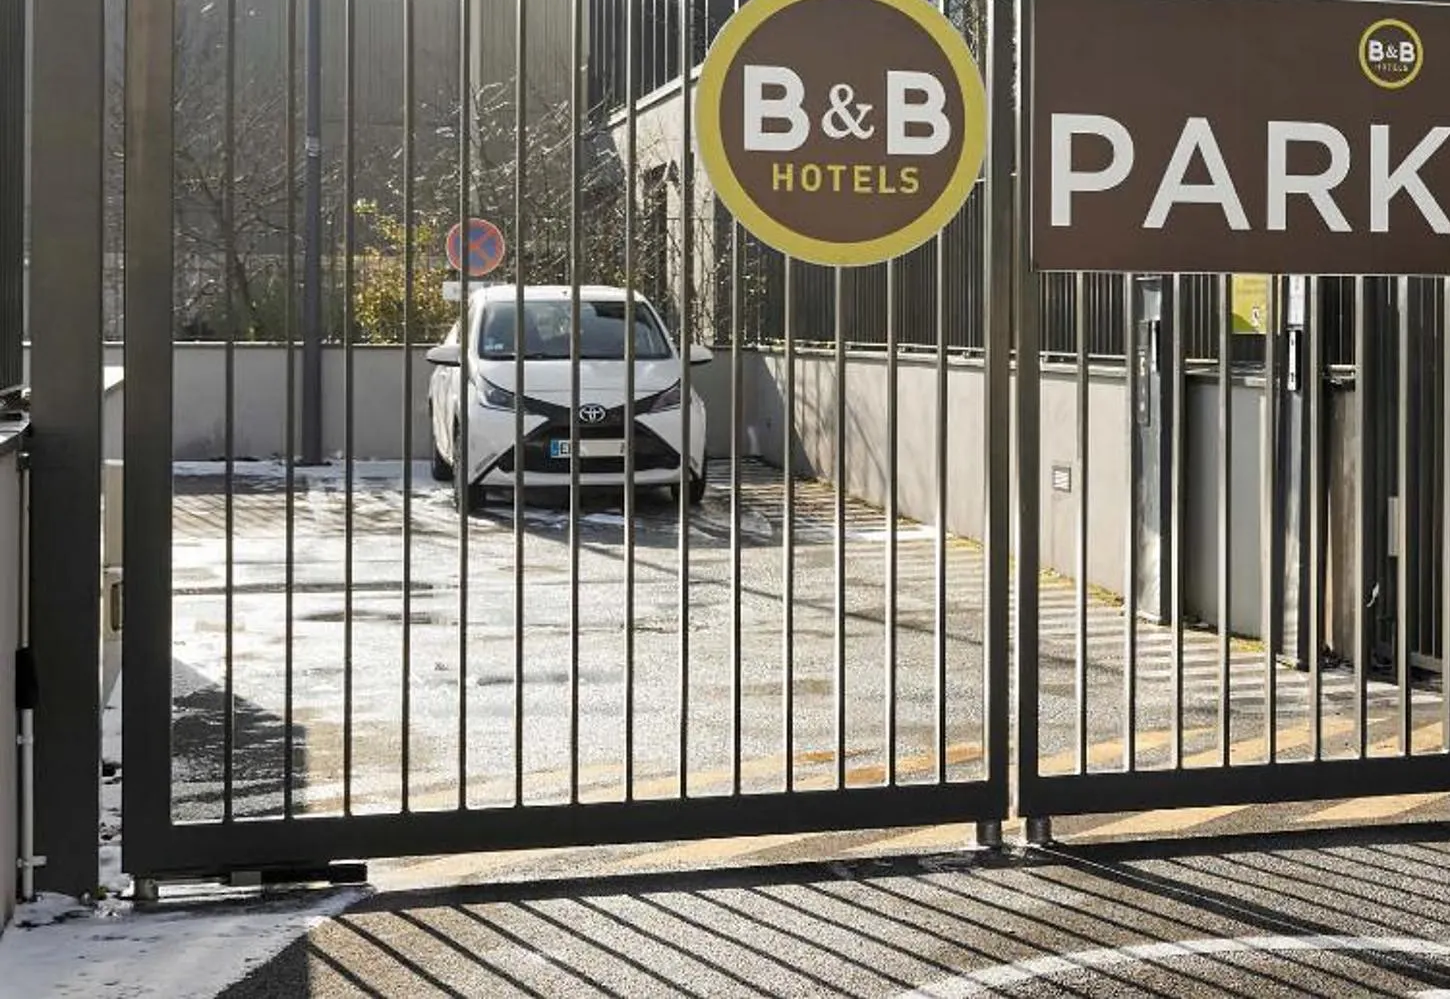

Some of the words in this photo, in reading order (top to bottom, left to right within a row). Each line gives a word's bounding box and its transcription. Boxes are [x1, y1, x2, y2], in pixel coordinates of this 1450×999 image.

[1368, 39, 1416, 62] B&B
[743, 64, 951, 155] B&B
[771, 163, 920, 194] HOTELS
